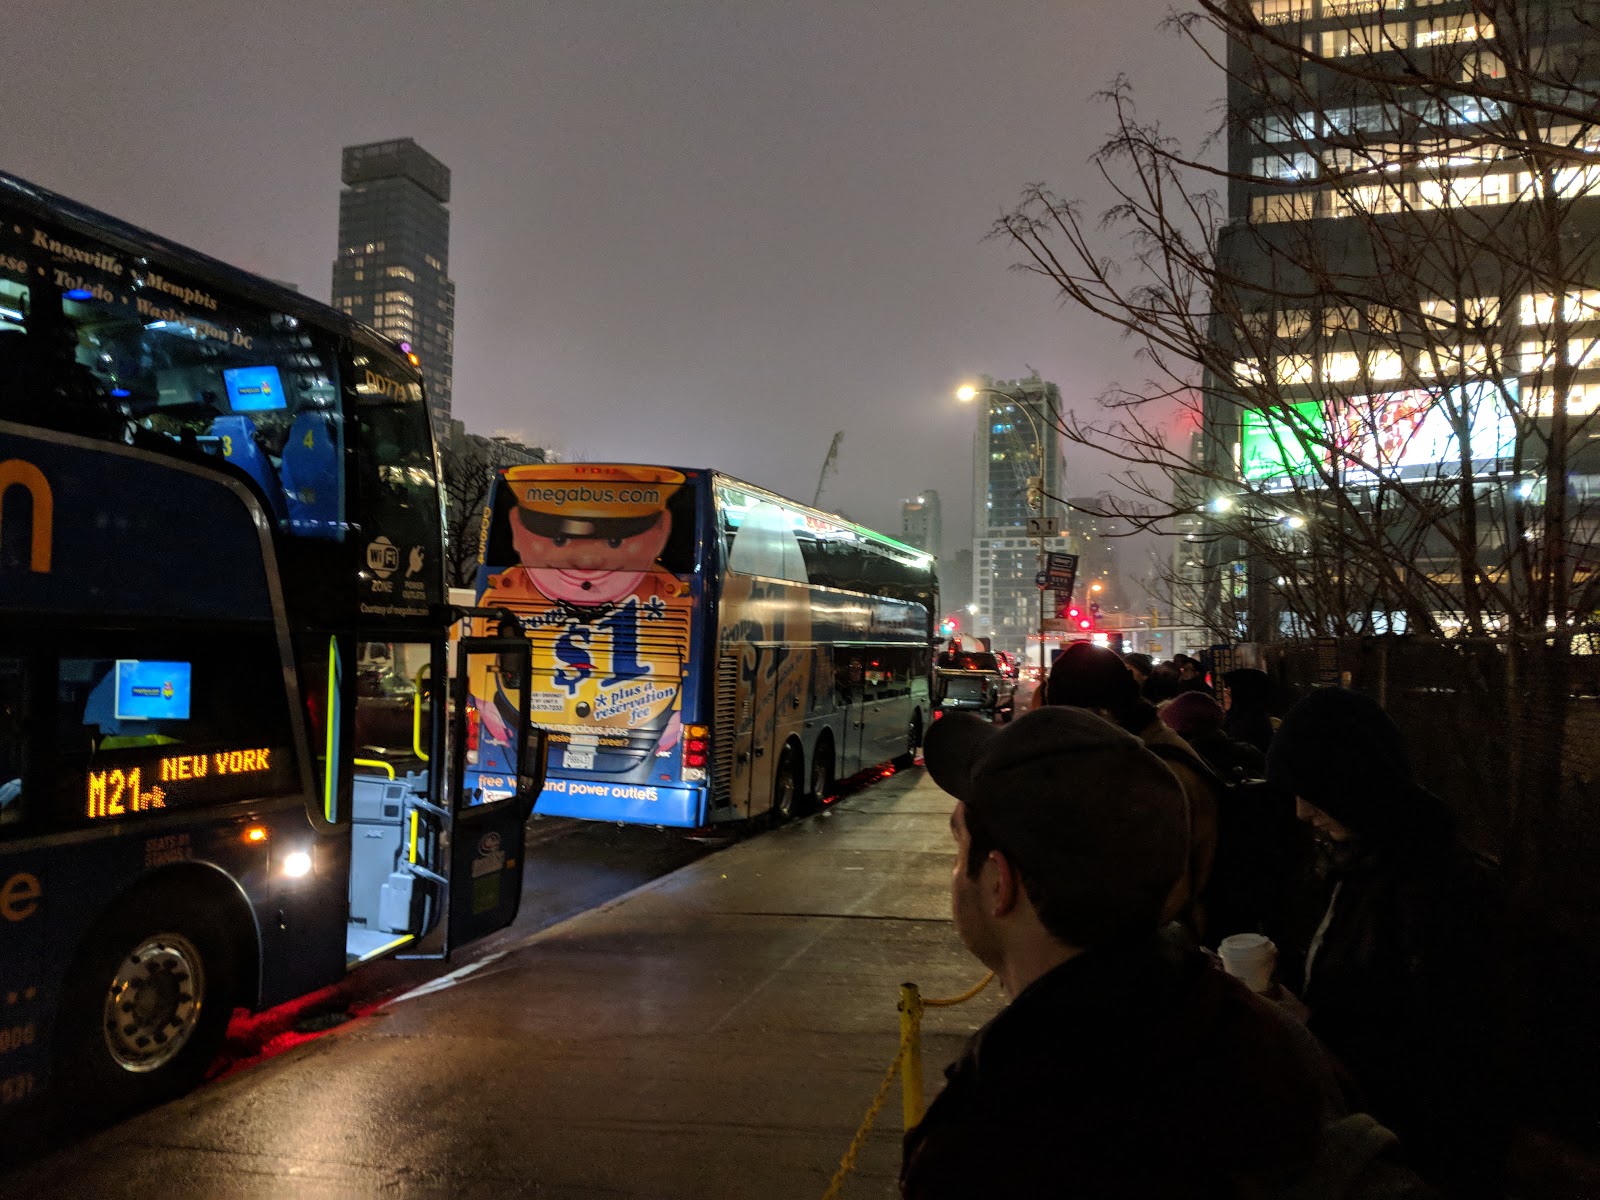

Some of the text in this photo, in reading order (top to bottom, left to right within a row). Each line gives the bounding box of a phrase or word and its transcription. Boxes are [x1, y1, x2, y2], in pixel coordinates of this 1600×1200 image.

[32, 228, 218, 311] Knoxville Memphis
[54, 268, 114, 303] Toledo
[136, 298, 229, 343] Washington
[223, 436, 232, 457] 3
[304, 430, 314, 449] 4
[526, 487, 660, 505] megabus.com
[594, 686, 677, 721] reservation
[611, 689, 641, 706] plus
[627, 705, 651, 726] fee
[88, 748, 269, 818] M21 NEW YORK
[478, 775, 504, 788] free
[543, 780, 566, 793] and
[569, 782, 609, 797] power
[612, 786, 658, 801] outlets
